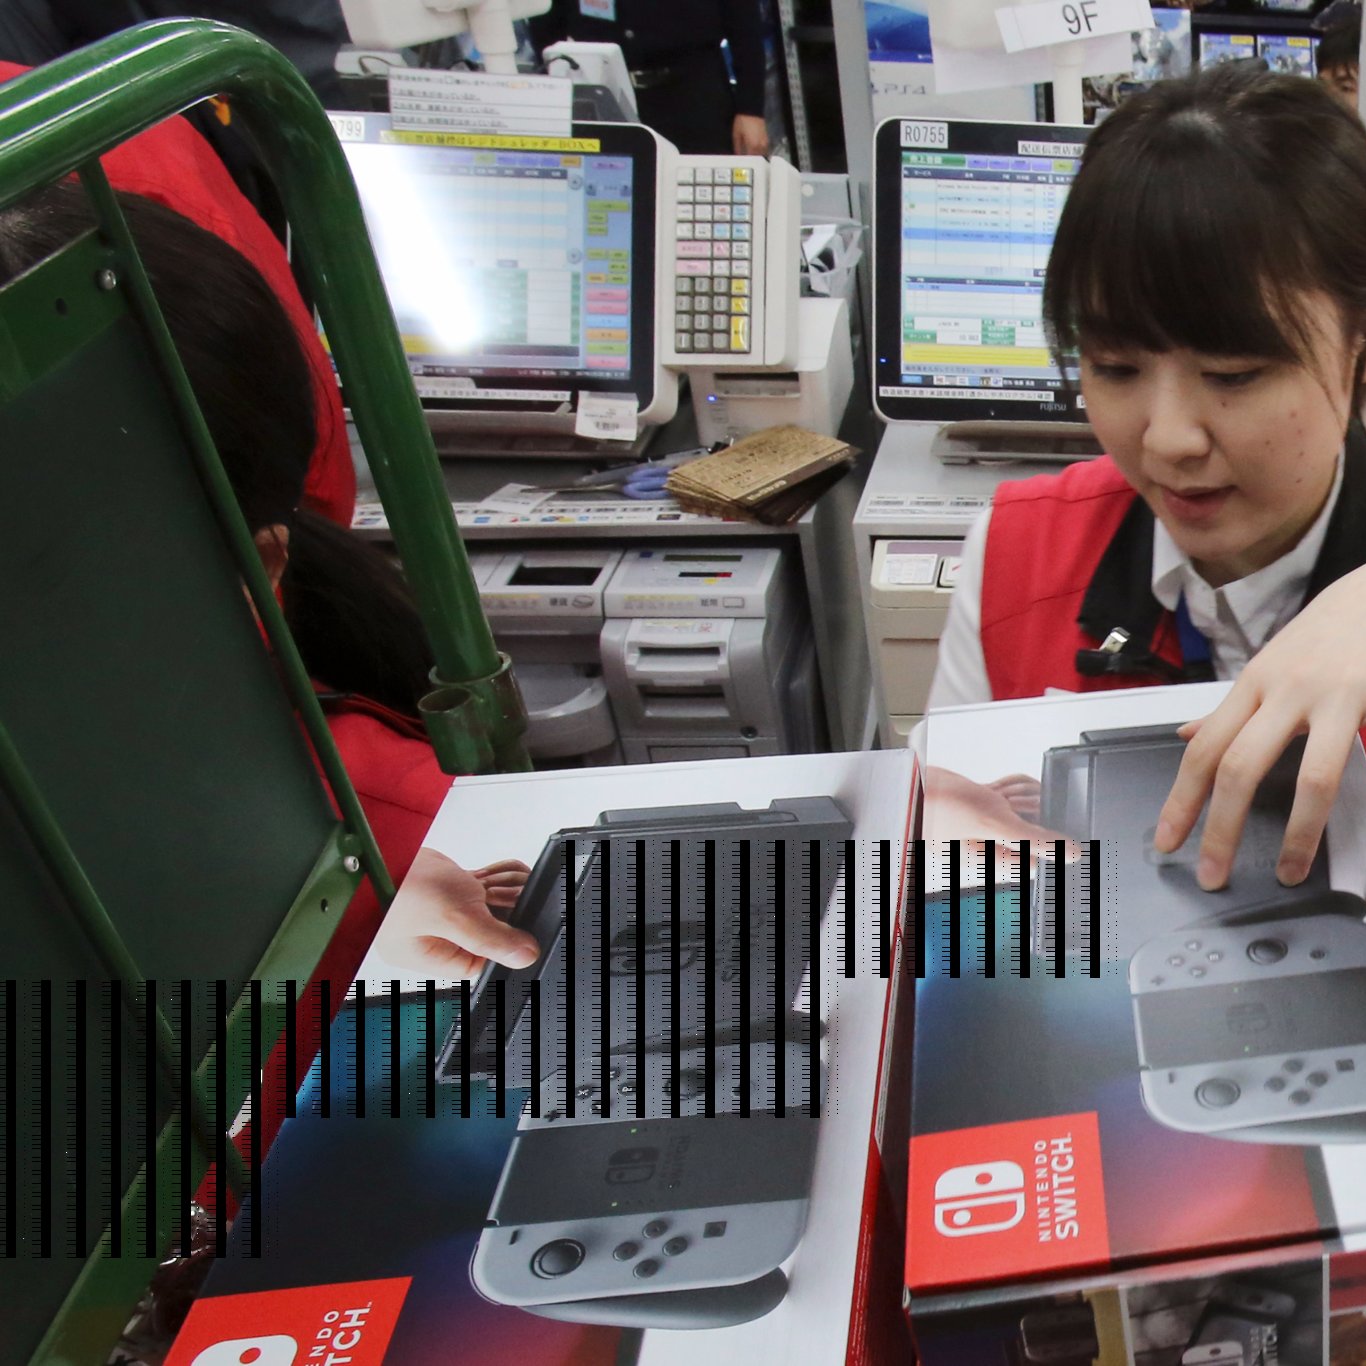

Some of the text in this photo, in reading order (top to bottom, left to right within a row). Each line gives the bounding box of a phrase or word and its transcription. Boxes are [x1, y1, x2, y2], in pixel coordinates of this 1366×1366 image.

[1062, 0, 1099, 35] 9F
[904, 127, 945, 143] R0755
[1040, 403, 1067, 411] FUJITSU
[1034, 1140, 1052, 1242] NINTENDO
[1050, 1136, 1079, 1241] SWITCH
[305, 1310, 340, 1366] NDO
